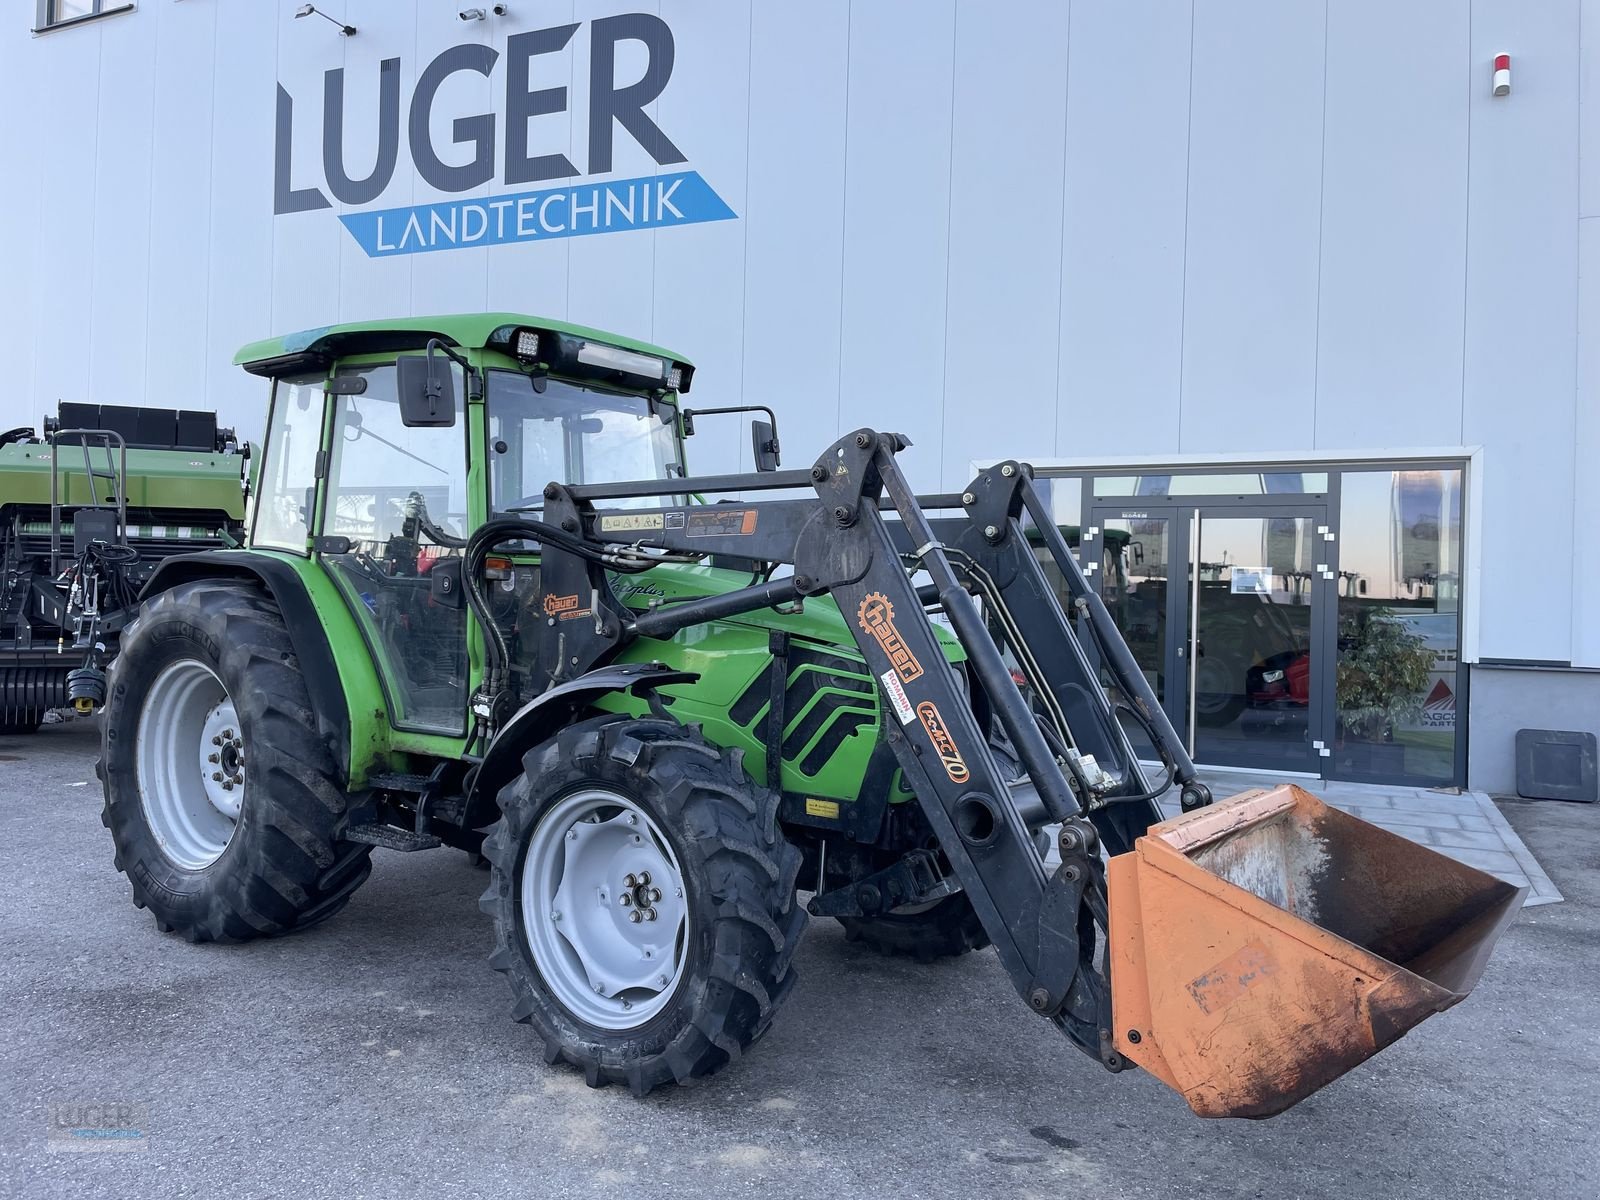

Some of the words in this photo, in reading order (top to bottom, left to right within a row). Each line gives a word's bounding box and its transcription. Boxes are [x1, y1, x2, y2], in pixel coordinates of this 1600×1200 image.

[273, 13, 689, 215] LUGER
[377, 178, 687, 251] LANDTECHNIK
[548, 598, 576, 611] hauer
[865, 603, 917, 674] hauer
[888, 671, 911, 713] ROMANN
